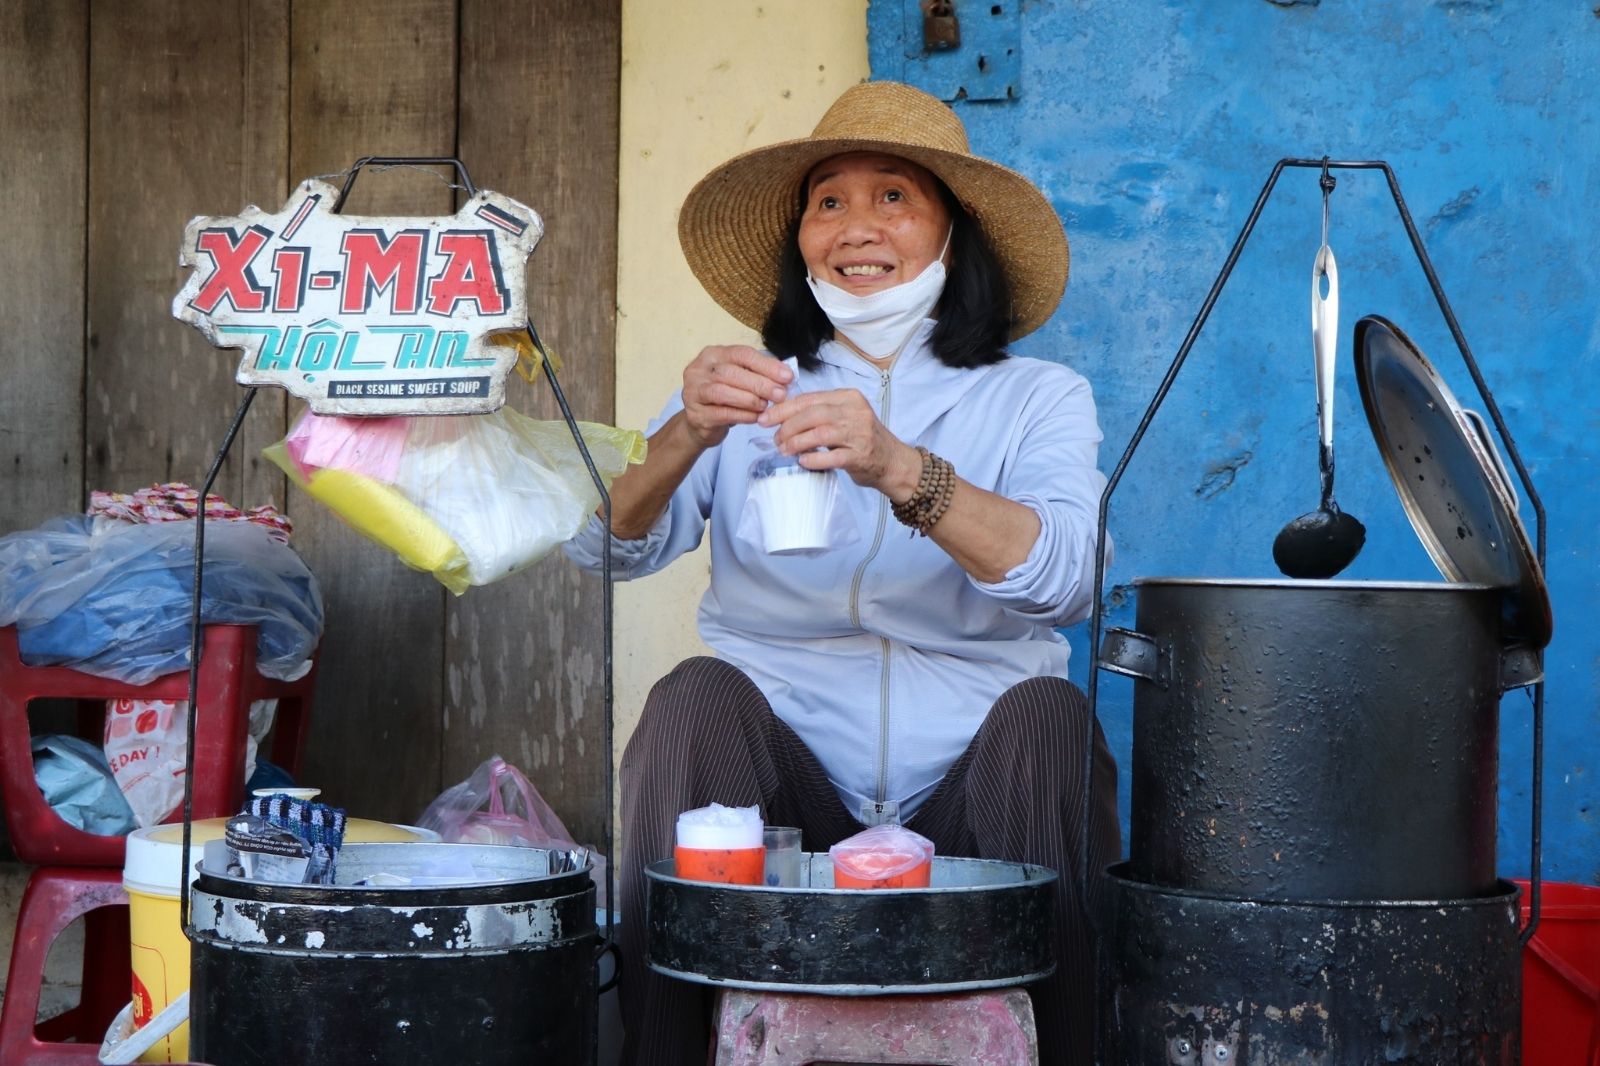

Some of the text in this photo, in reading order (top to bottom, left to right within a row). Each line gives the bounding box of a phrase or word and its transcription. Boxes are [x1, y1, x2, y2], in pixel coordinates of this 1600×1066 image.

[336, 380, 481, 395] BLACK SESAME SWEET SOUP
